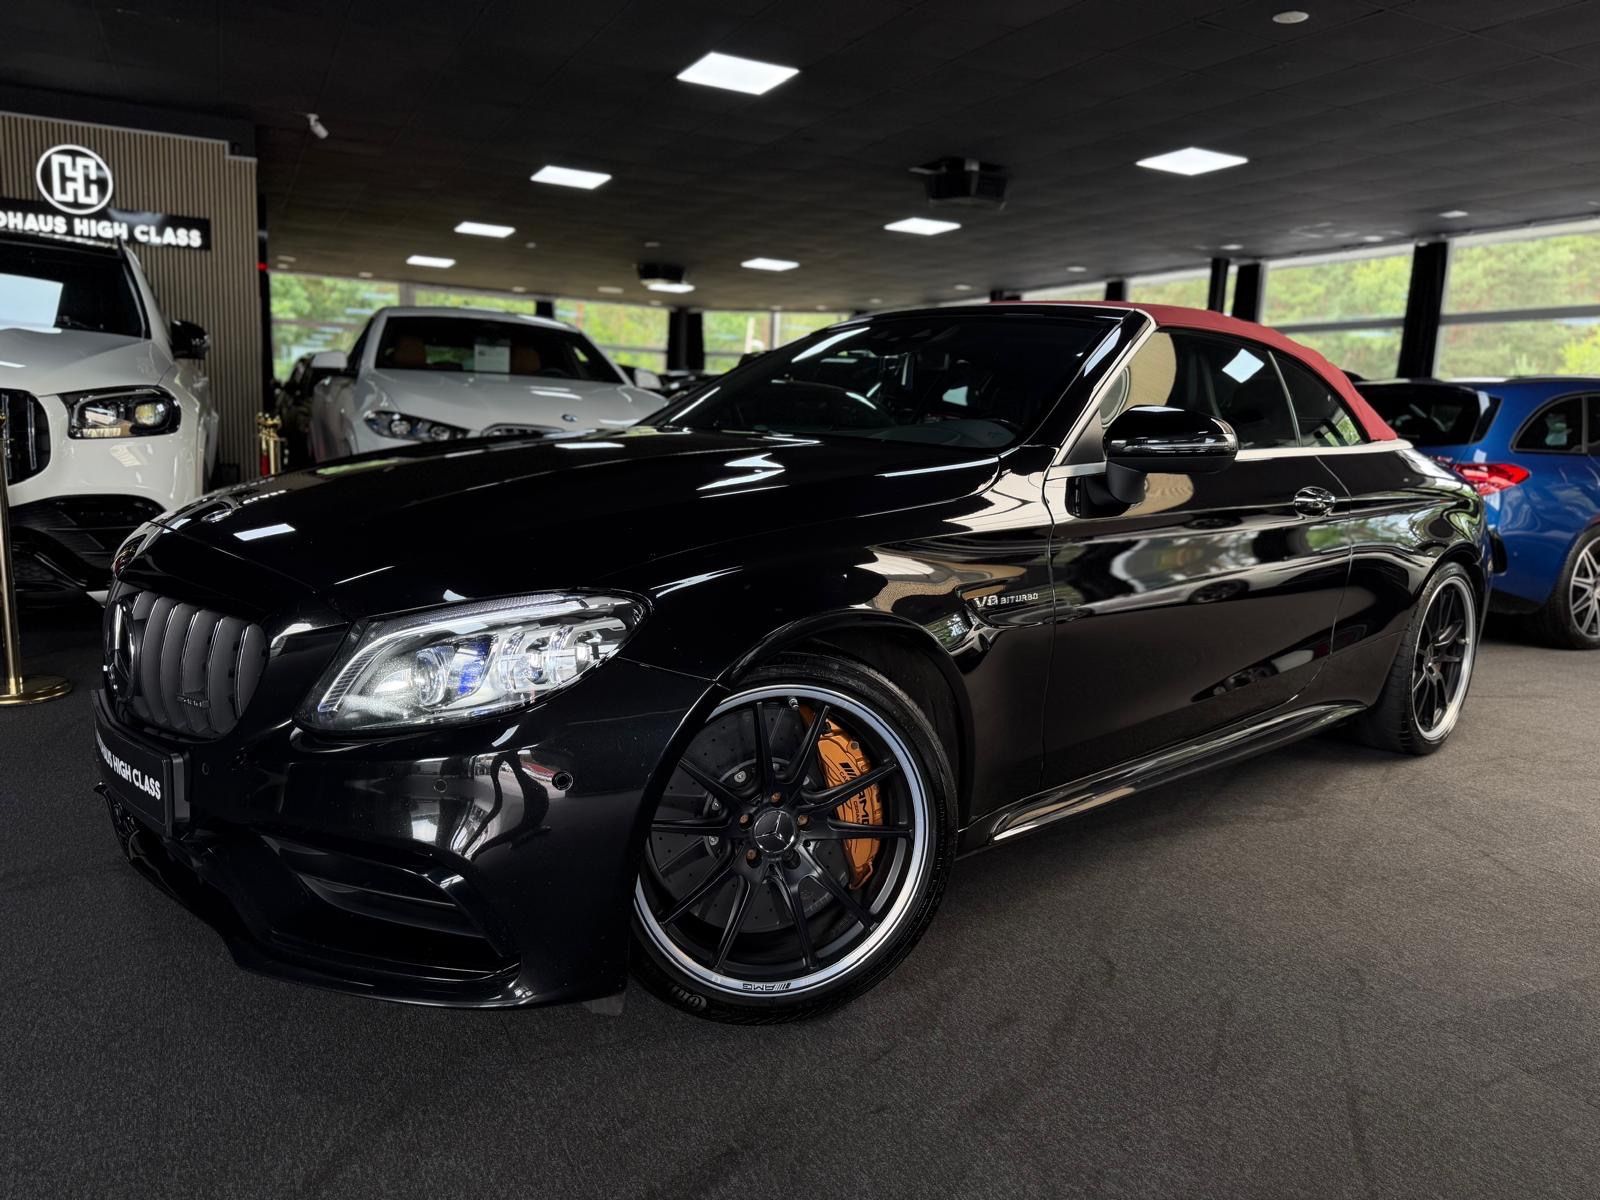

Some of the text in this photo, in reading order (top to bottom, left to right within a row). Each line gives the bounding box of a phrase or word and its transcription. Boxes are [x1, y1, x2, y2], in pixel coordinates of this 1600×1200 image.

[74, 217, 129, 241] HIGH
[134, 224, 202, 248] CLASS
[973, 593, 1039, 608] V8 BITURBO
[112, 754, 161, 800] HIGH CLASS
